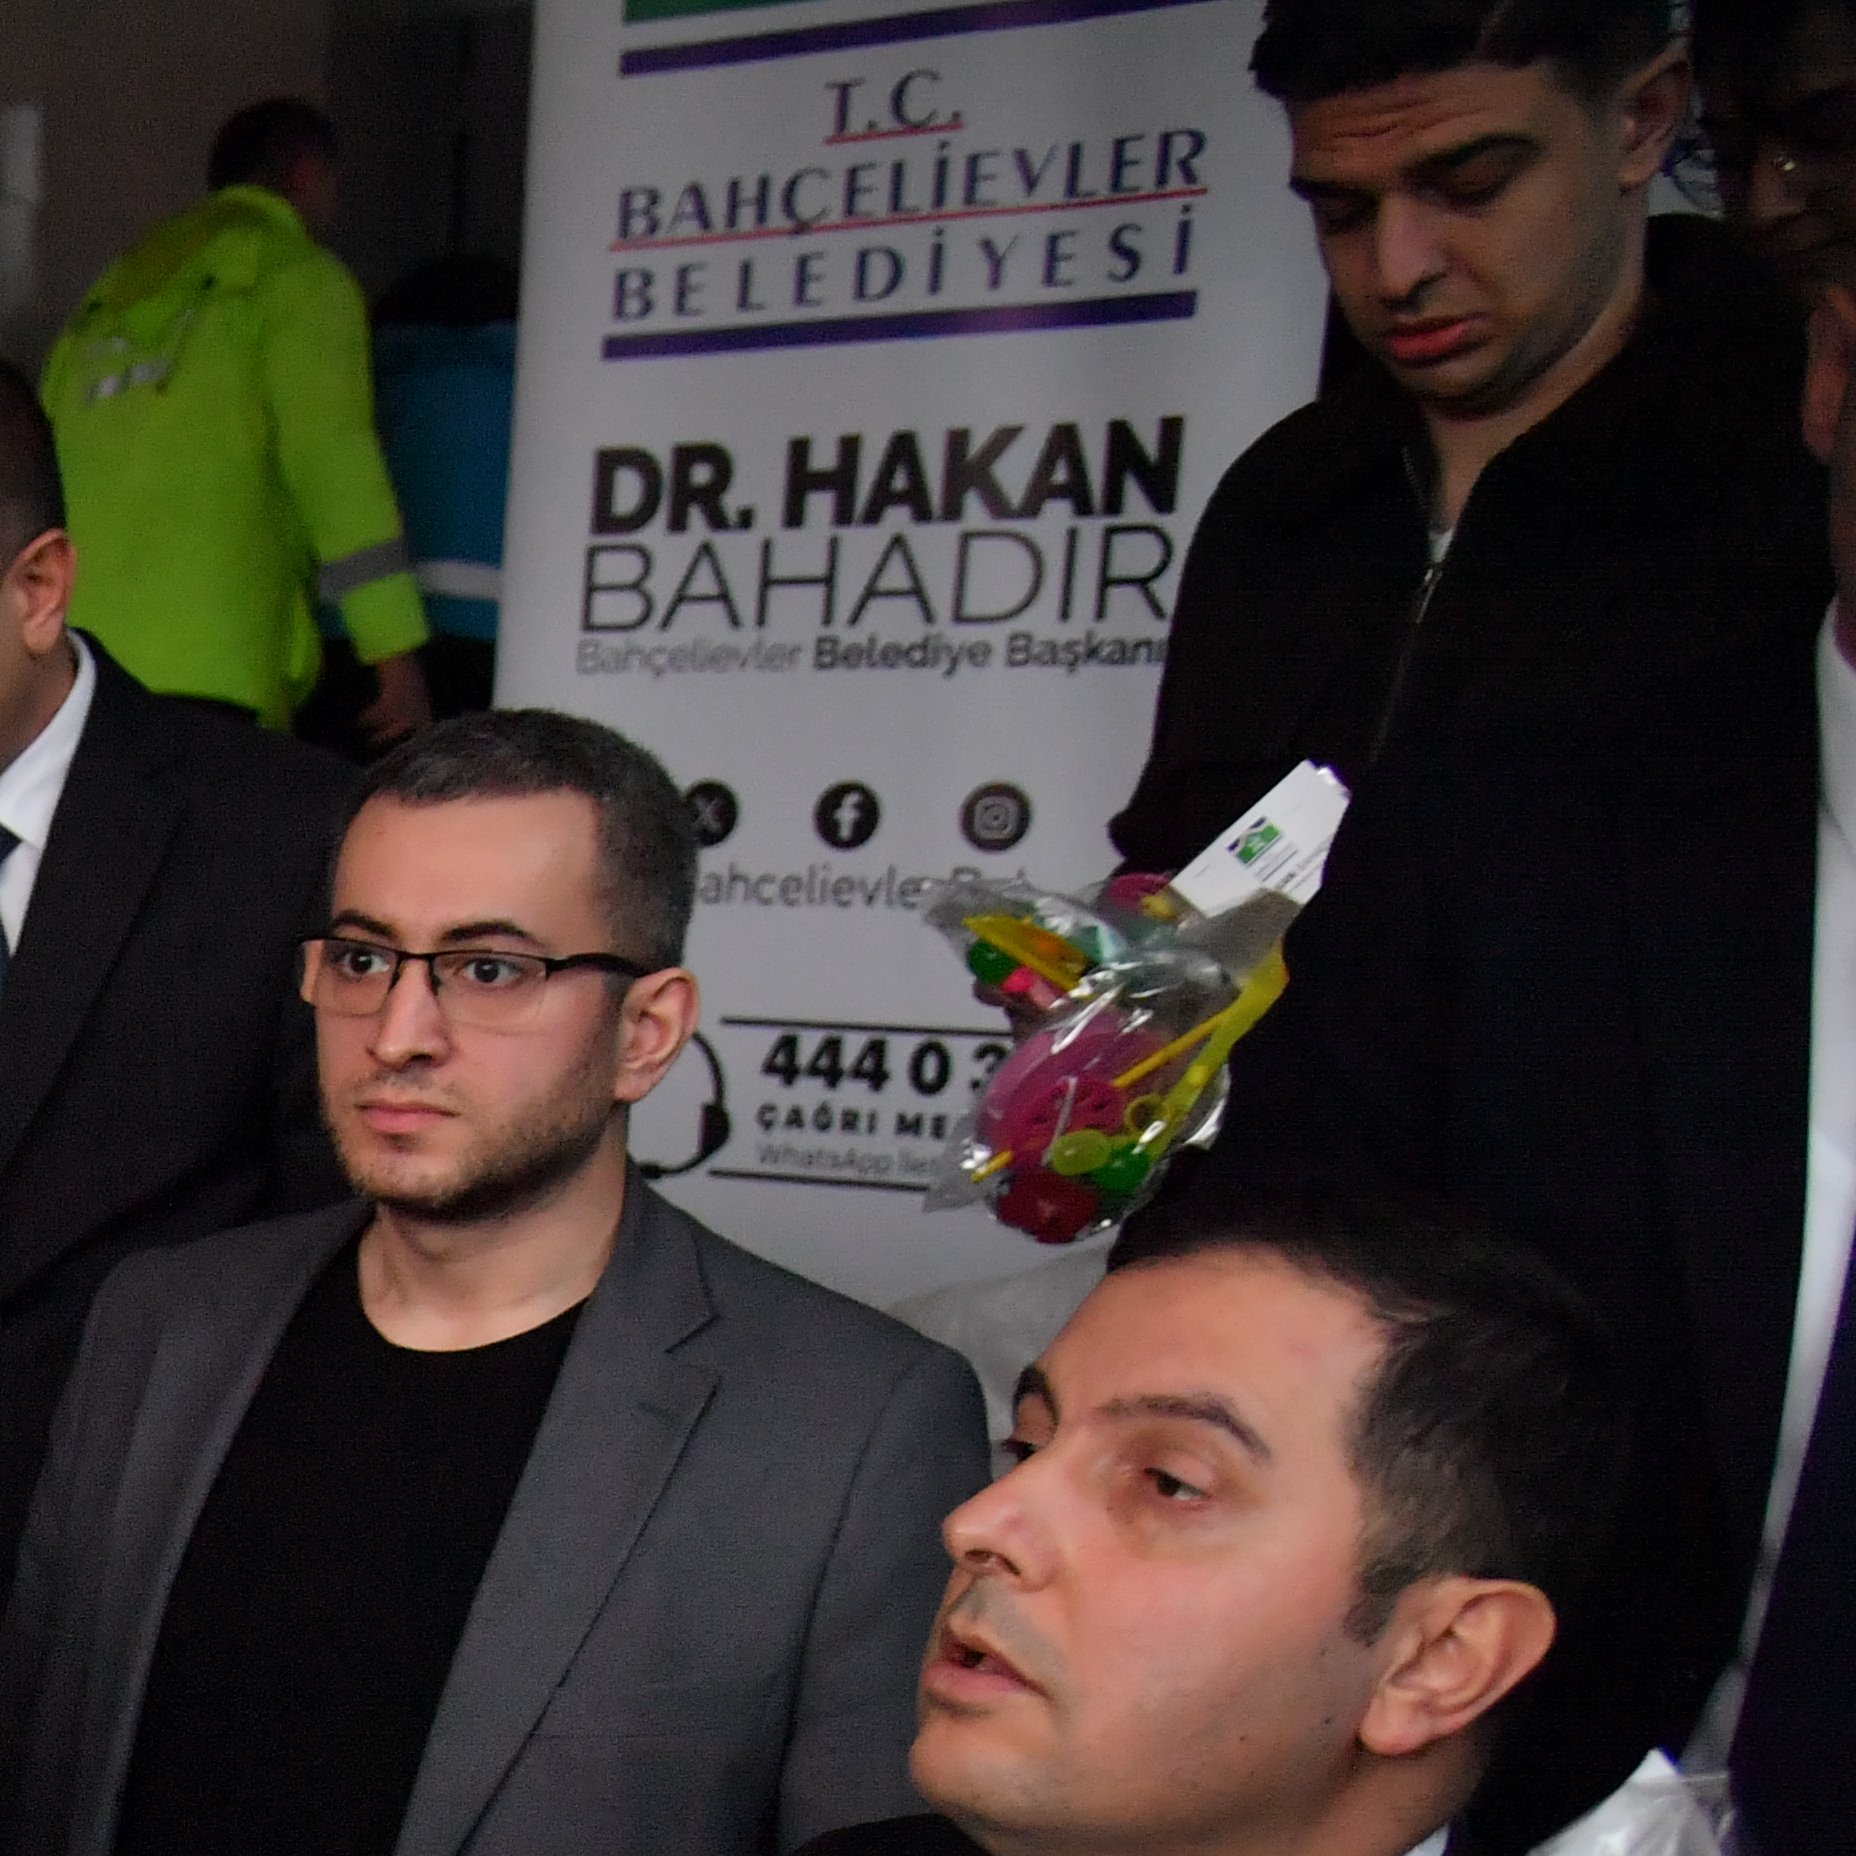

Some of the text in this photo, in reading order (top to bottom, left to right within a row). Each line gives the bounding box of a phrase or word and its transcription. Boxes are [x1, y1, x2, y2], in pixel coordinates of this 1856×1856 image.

[825, 69, 962, 134] T.C.
[617, 128, 1208, 241] BAHÇELİEVLER
[612, 204, 1195, 324] BELEDİYESİ
[591, 416, 1185, 535] DR. HAKAN
[582, 524, 1175, 634] BAHADIR
[576, 637, 802, 678] Bahçelievler
[814, 634, 993, 680] Belediye
[756, 1100, 878, 1137] ÇAĞRI
